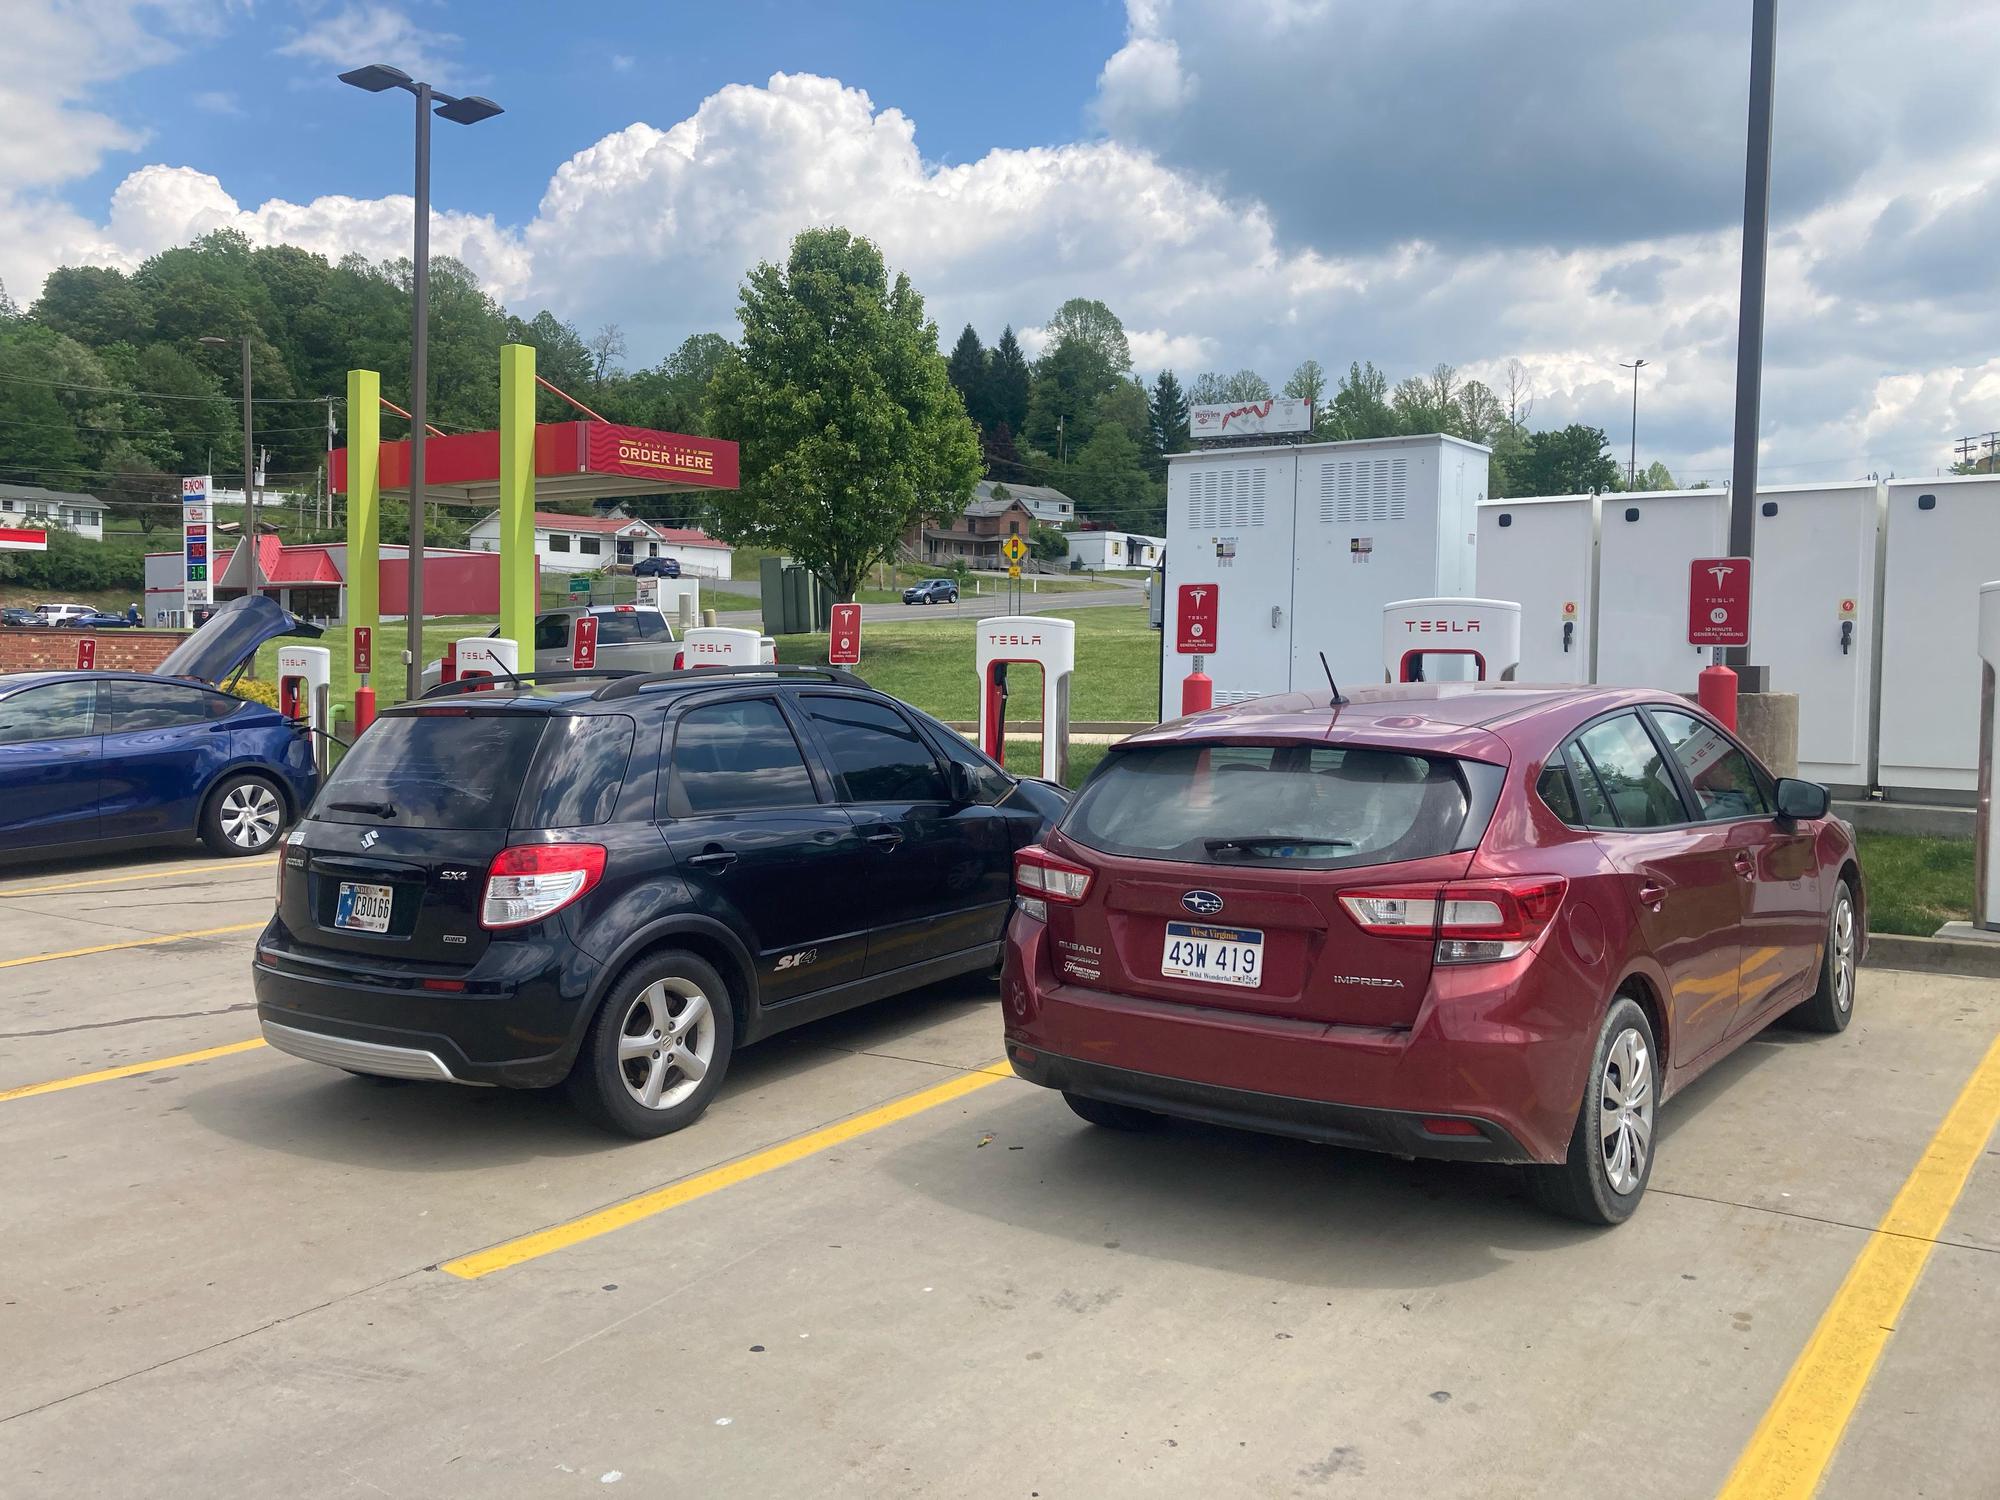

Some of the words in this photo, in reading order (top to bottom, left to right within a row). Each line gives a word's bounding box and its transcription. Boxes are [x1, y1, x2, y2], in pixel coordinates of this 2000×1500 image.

[619, 446, 670, 464] ORDER
[675, 454, 713, 469] HERE
[183, 479, 204, 493] EXXON
[1404, 620, 1481, 632] TESLA
[989, 635, 1041, 645] TESLA
[692, 643, 732, 653] TESLA
[461, 651, 492, 660] TESLA
[281, 659, 307, 667] TESLA
[440, 871, 468, 881] SX4
[444, 935, 466, 944] AWD
[1190, 927, 1208, 937] West
[1208, 929, 1239, 940] Virginia
[1058, 940, 1102, 955] SUBARU
[774, 948, 817, 971] SX4
[1169, 941, 1208, 969] 43W
[1215, 946, 1255, 973] 419
[1203, 971, 1232, 981] Wonderful
[1333, 975, 1405, 988] IMPREZA
